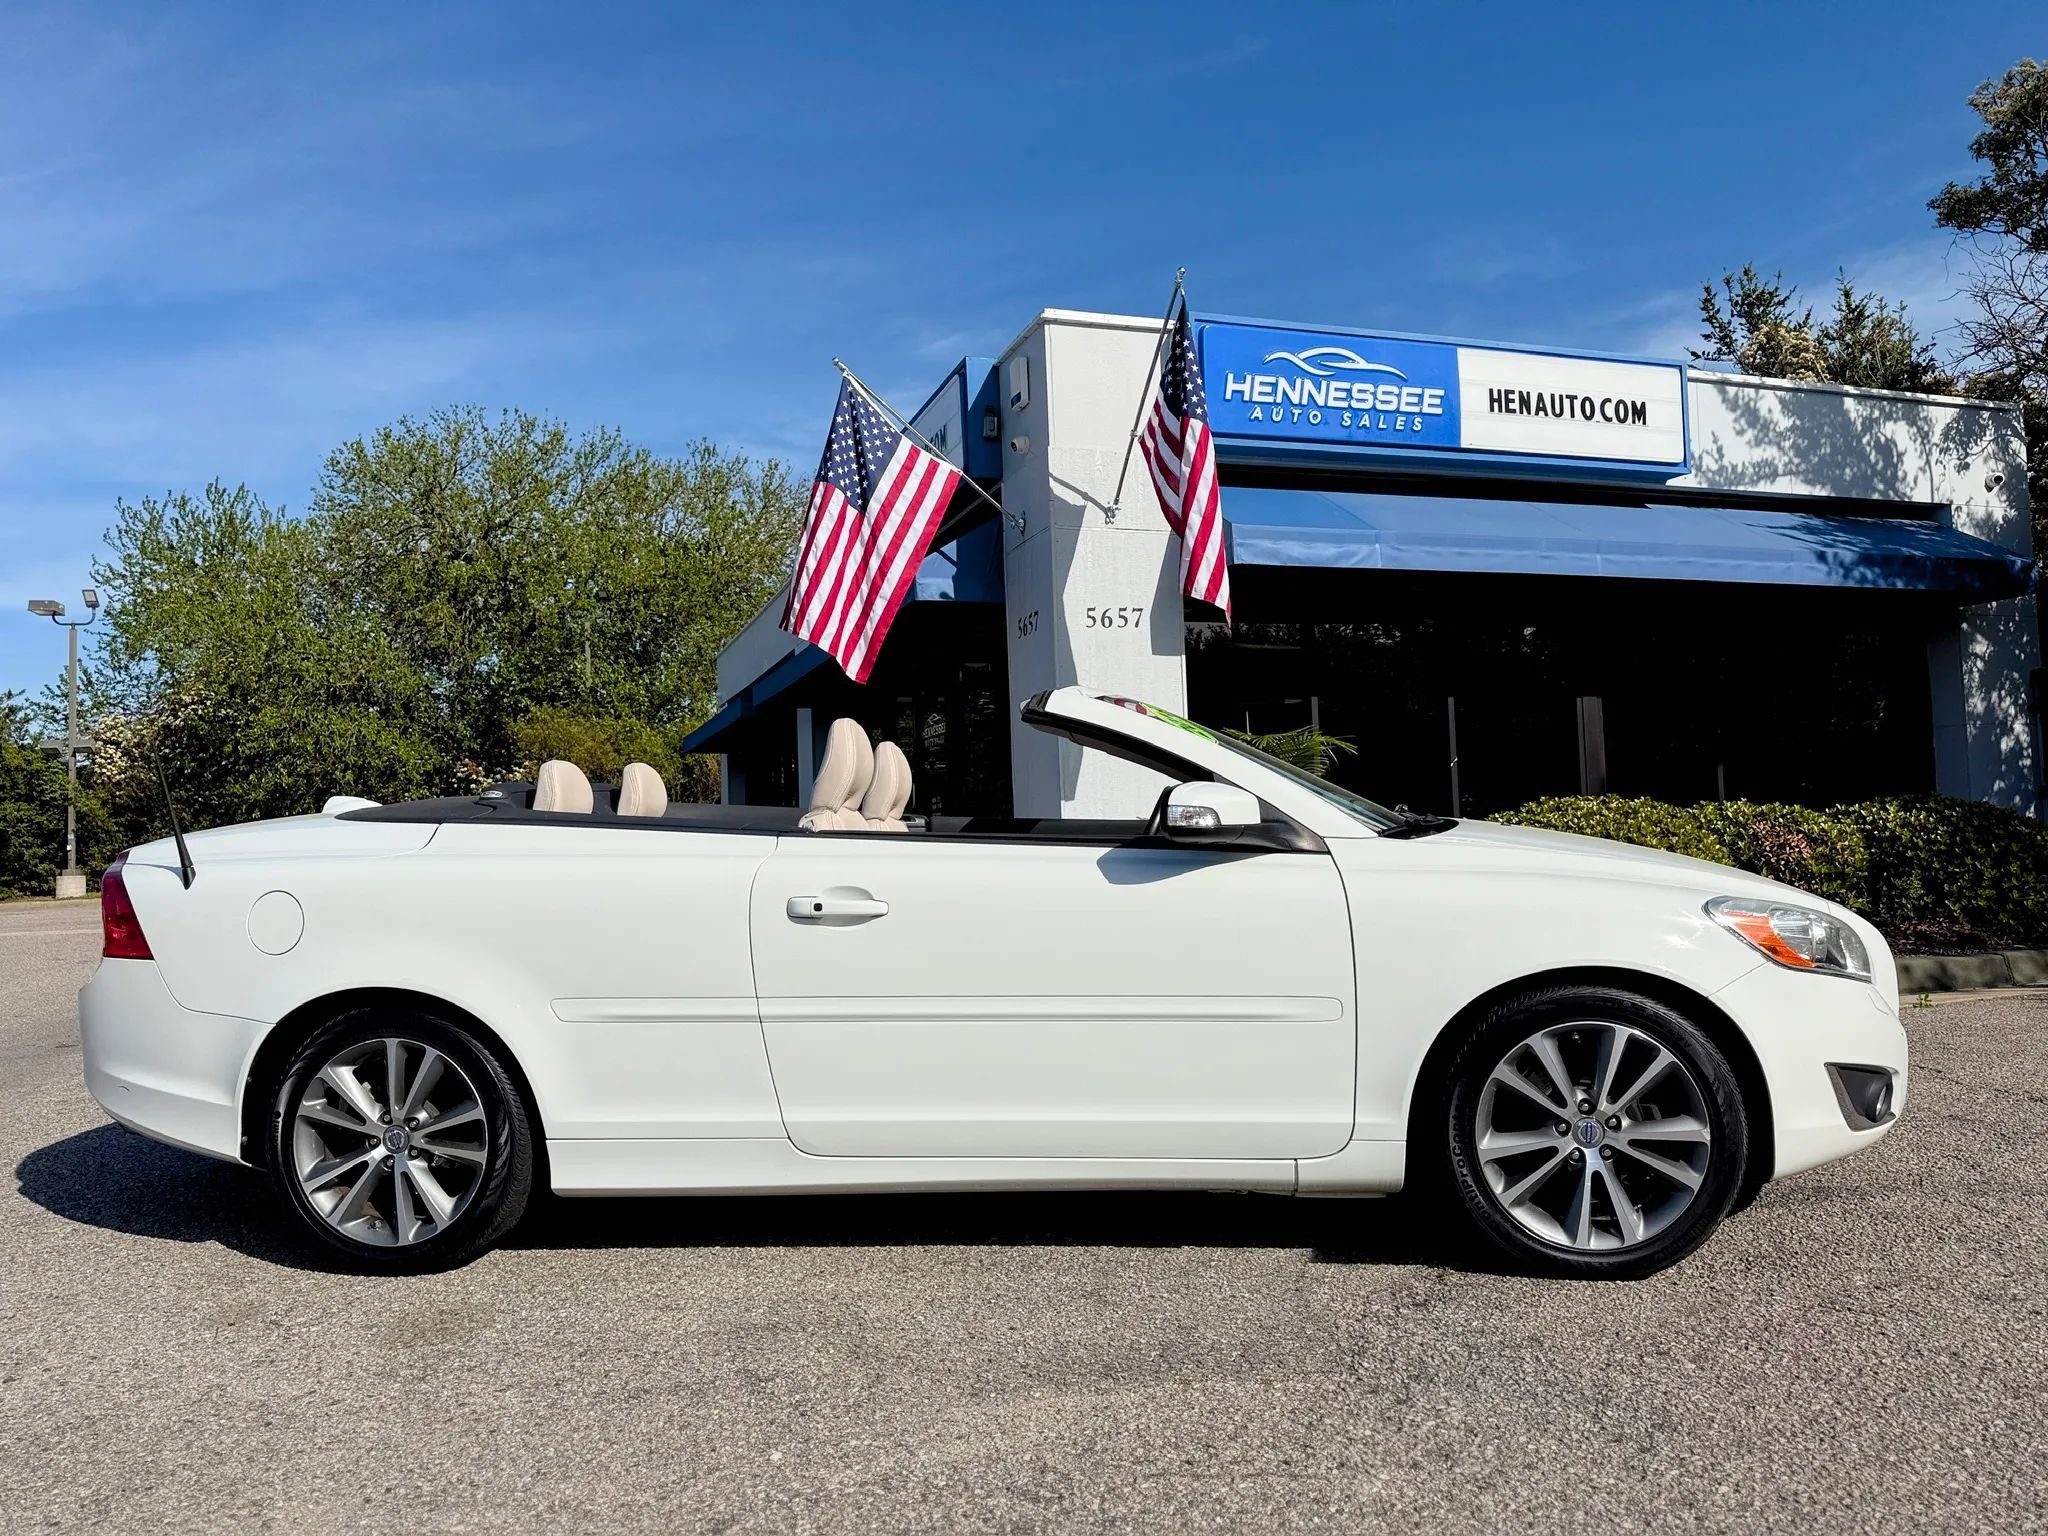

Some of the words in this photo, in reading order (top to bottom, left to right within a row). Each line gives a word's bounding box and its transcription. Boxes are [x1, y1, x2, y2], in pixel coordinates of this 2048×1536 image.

[1224, 372, 1446, 415] HENNESSEE
[1250, 405, 1322, 425] AUTO
[1341, 411, 1423, 432] SALES
[1017, 610, 1039, 639] 5657
[1085, 606, 1143, 628] 5657
